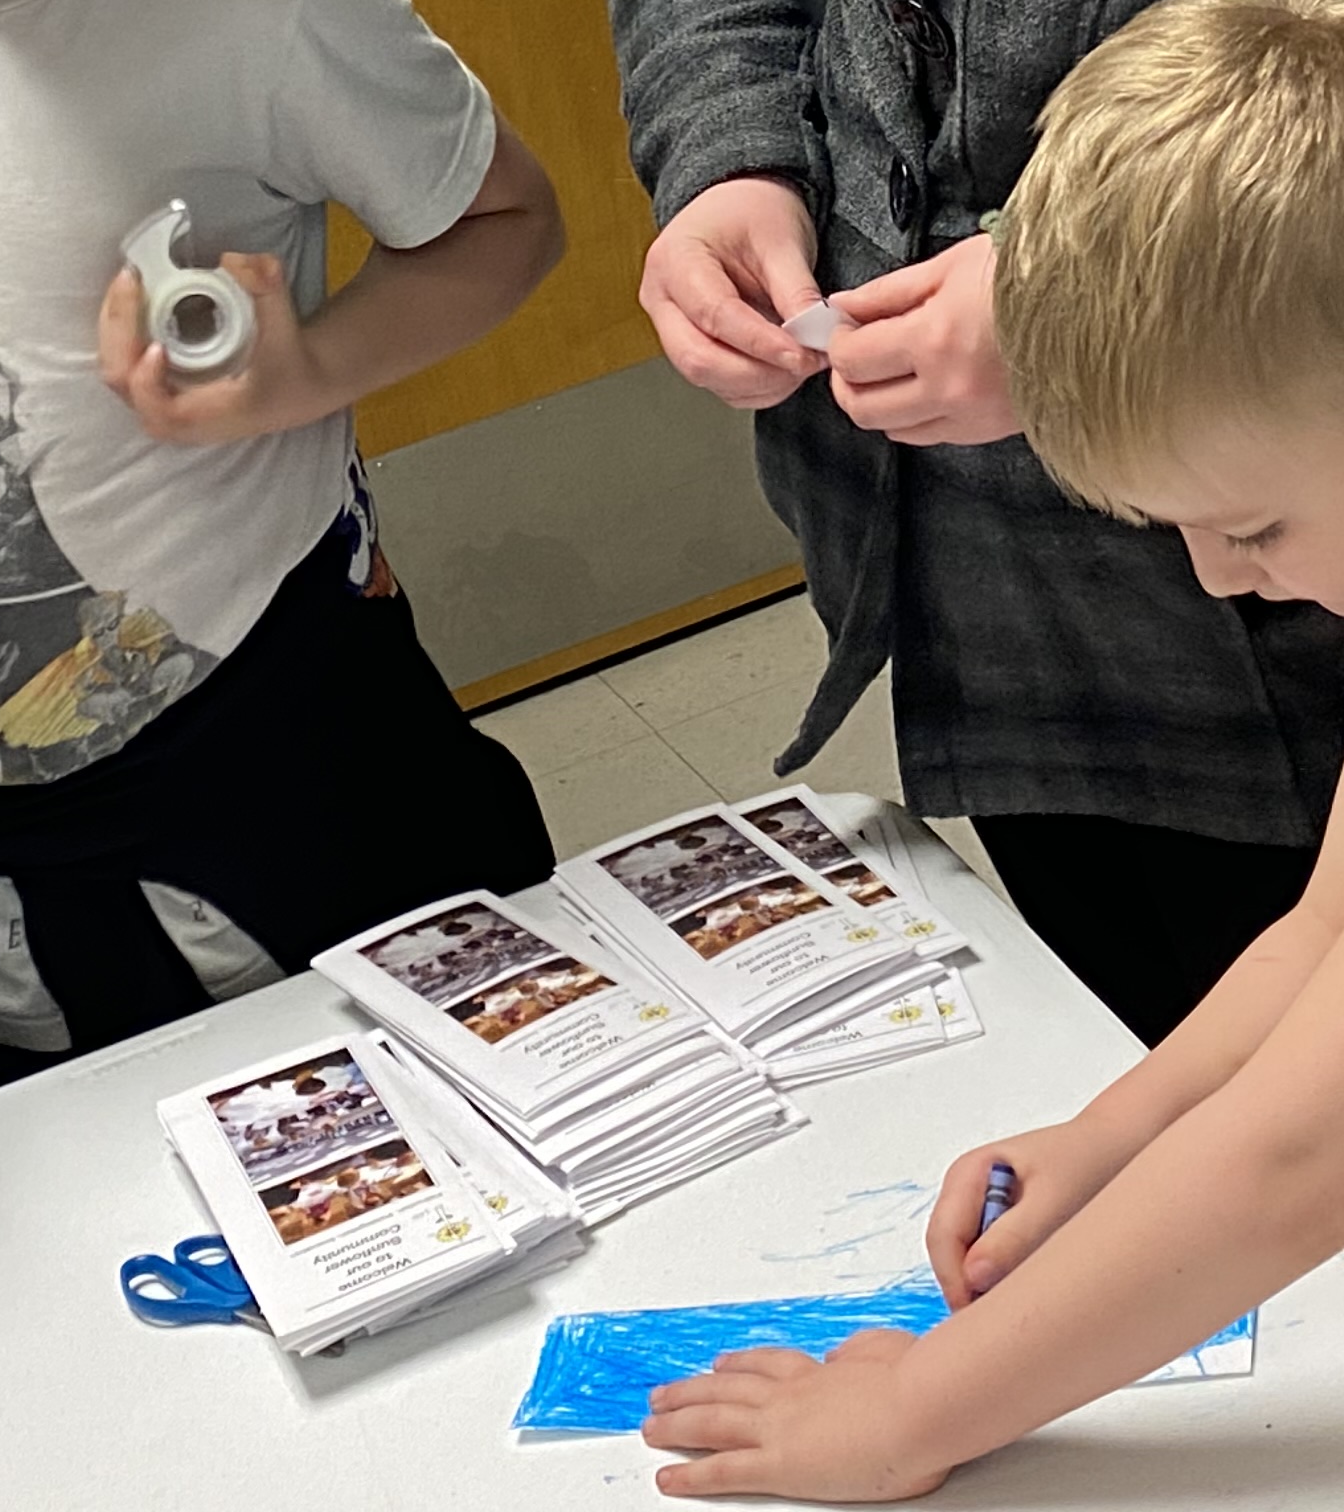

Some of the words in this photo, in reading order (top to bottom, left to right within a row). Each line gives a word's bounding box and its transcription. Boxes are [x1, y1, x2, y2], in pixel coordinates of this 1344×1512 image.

[313, 1223, 401, 1266] Community
[324, 1235, 402, 1274] Sunflower
[375, 1252, 393, 1264] to
[338, 1257, 412, 1291] Welcome
[347, 1260, 372, 1277] our
